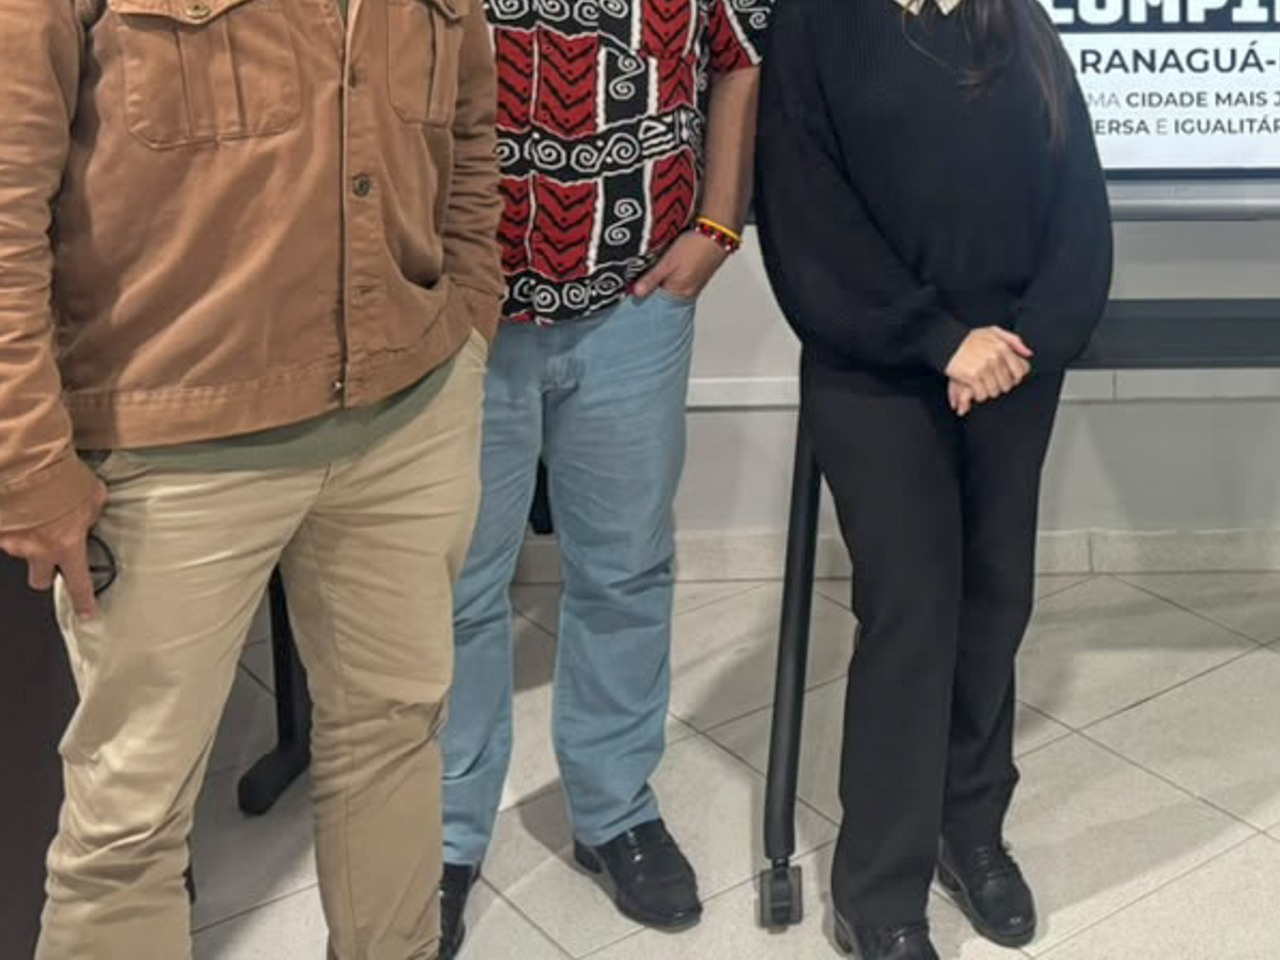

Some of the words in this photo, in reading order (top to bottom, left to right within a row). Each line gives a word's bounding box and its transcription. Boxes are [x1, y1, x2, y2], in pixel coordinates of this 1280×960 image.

[1088, 92, 1120, 107] MA
[1126, 91, 1208, 108] CIDADE
[1215, 91, 1268, 107] MAIS
[1094, 119, 1150, 135] ERSA
[1156, 118, 1168, 135] E
